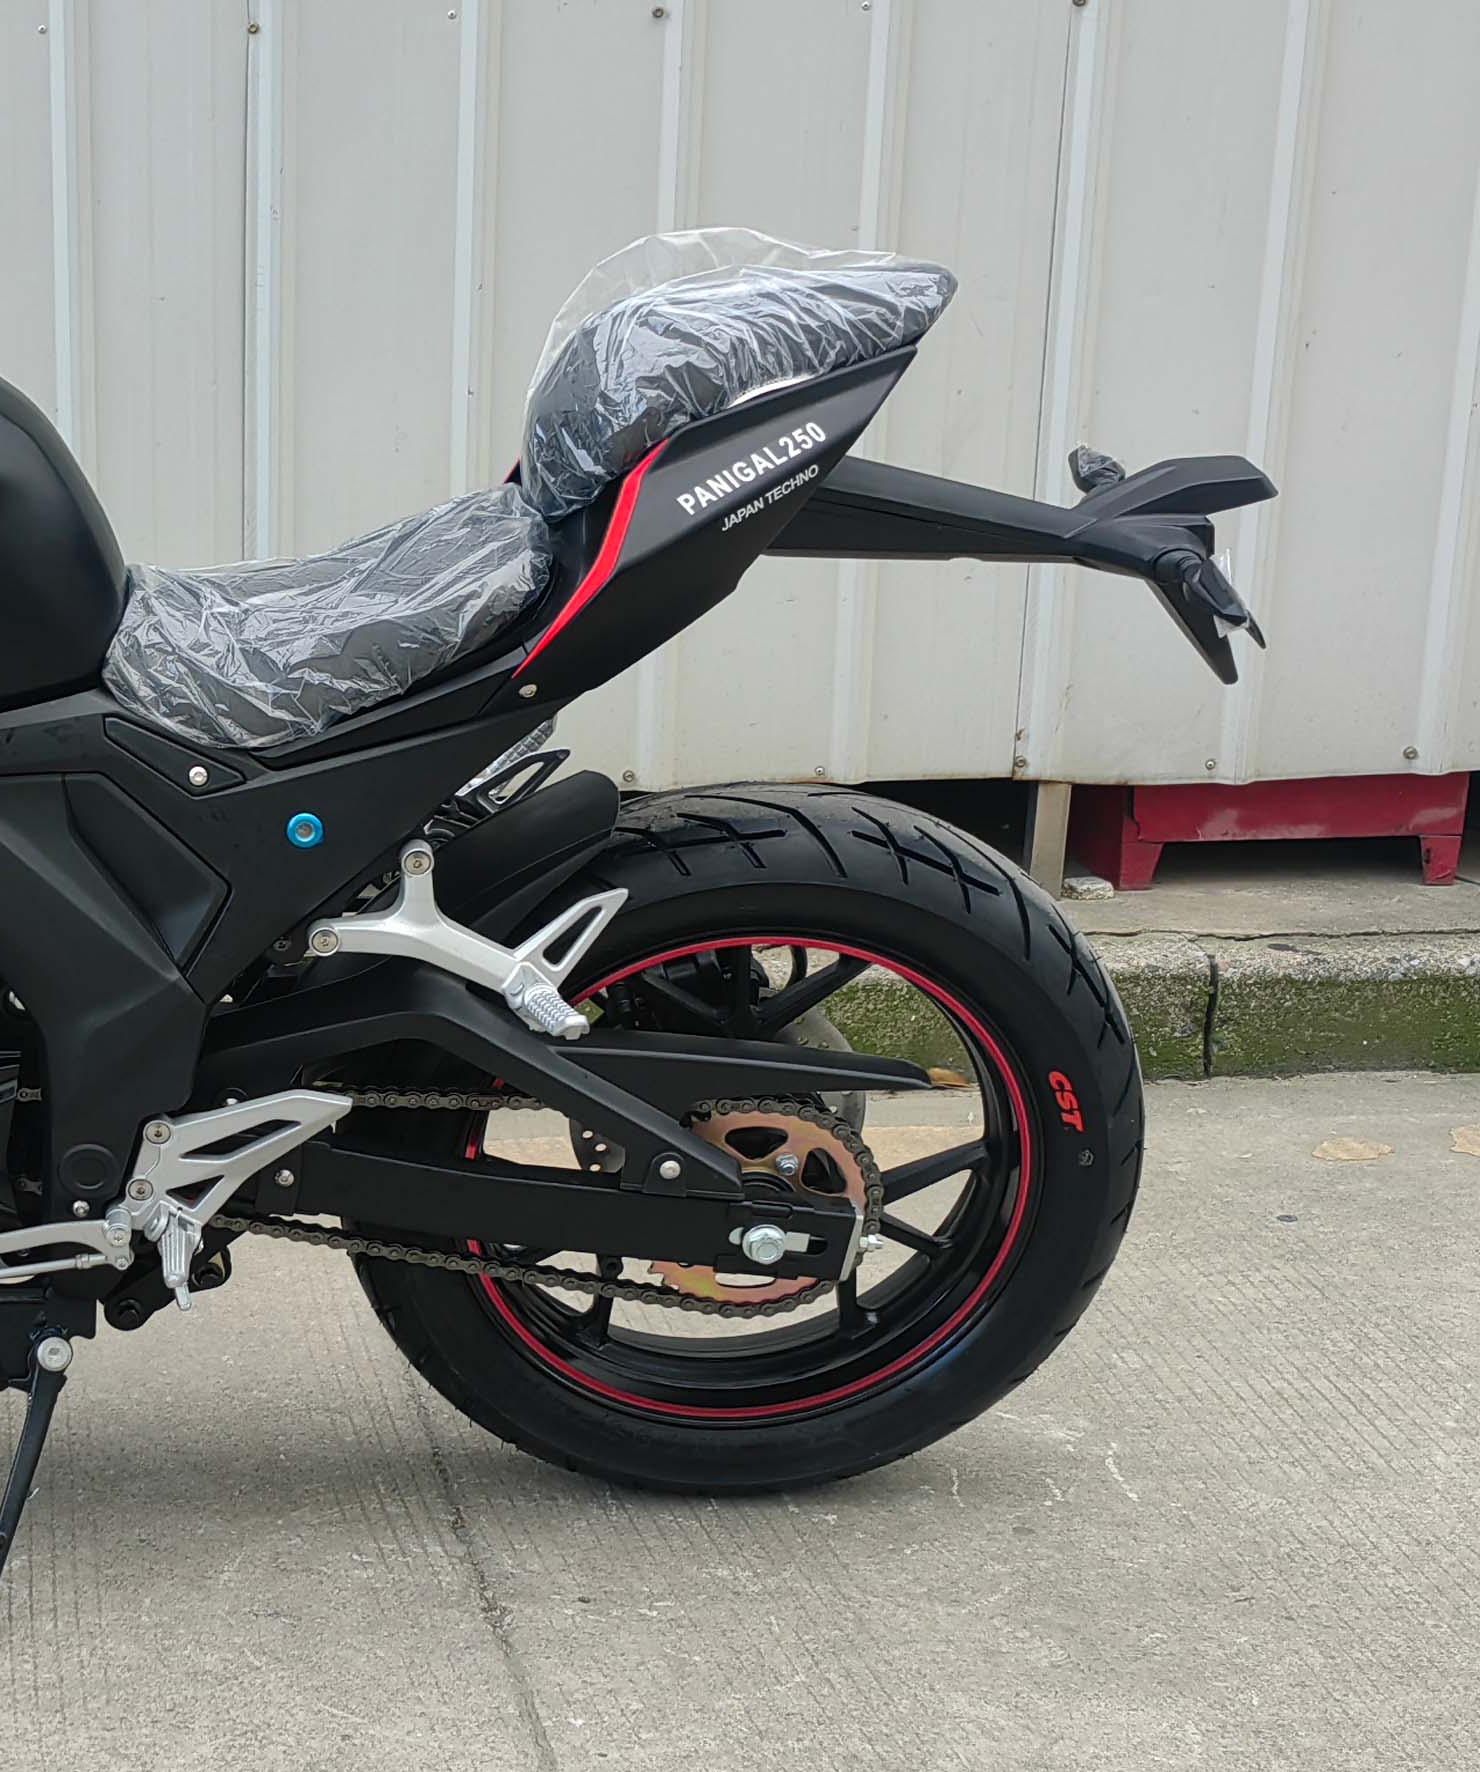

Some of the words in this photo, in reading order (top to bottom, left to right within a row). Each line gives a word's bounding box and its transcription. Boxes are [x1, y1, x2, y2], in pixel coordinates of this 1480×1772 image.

[721, 497, 764, 532] JAPAN
[764, 464, 819, 505] TECHNO
[1048, 1071, 1085, 1133] CST
